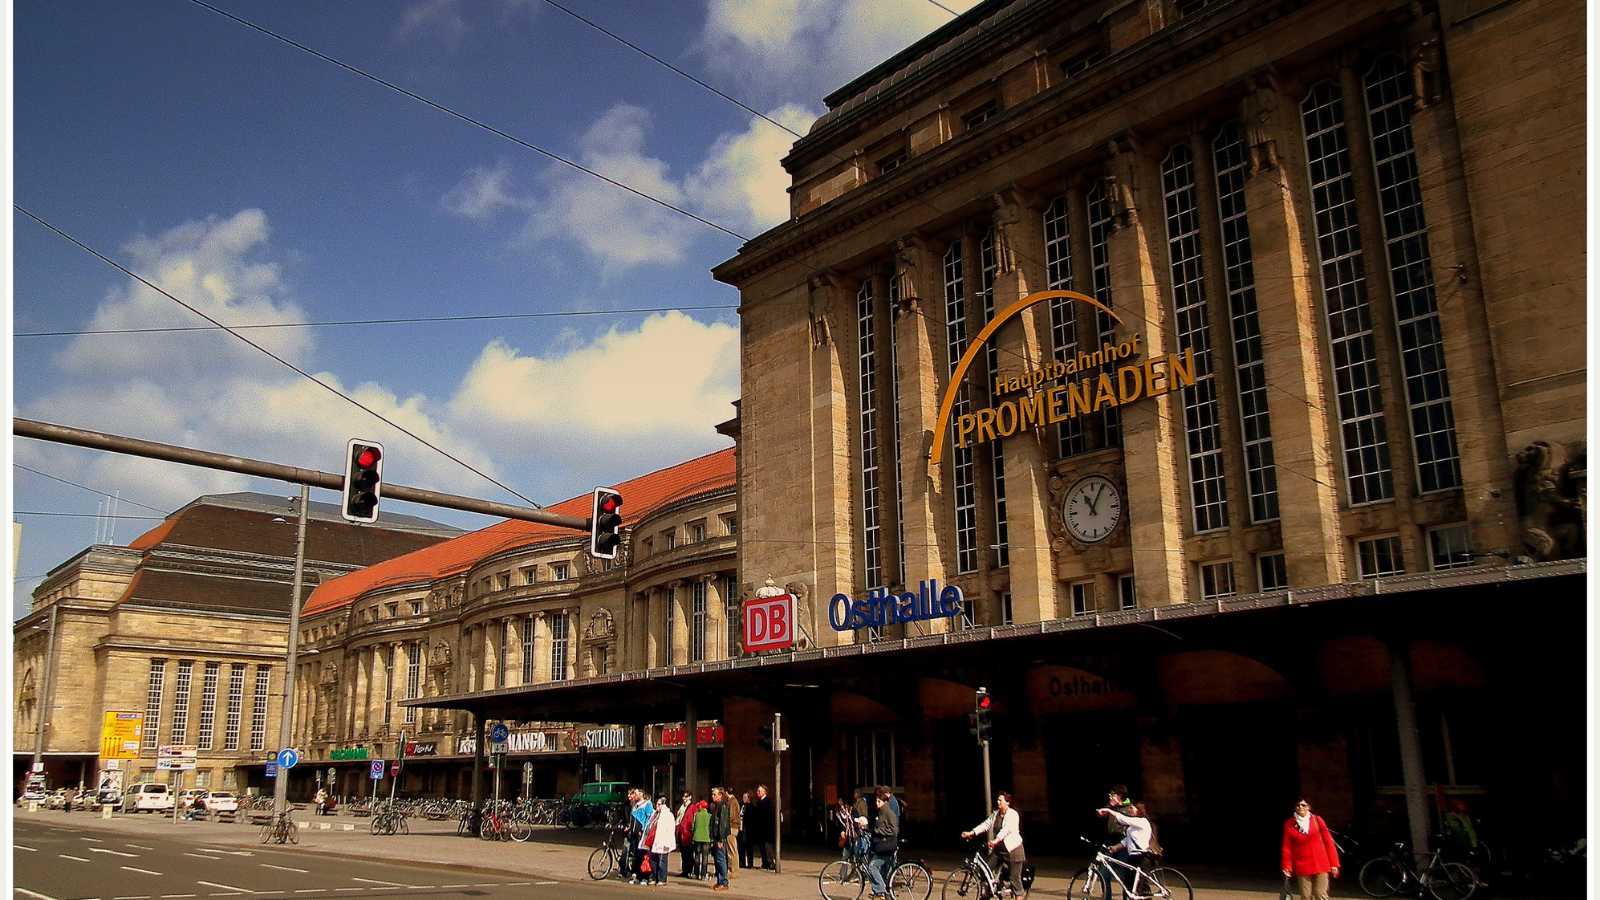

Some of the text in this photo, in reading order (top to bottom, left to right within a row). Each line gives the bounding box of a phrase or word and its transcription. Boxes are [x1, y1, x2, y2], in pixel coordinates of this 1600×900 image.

[994, 333, 1142, 397] Hauptbahnhof
[957, 346, 1196, 449] PROMENADEN
[750, 603, 787, 642] DB
[828, 579, 963, 631] Osthalle
[585, 727, 624, 749] SATURN
